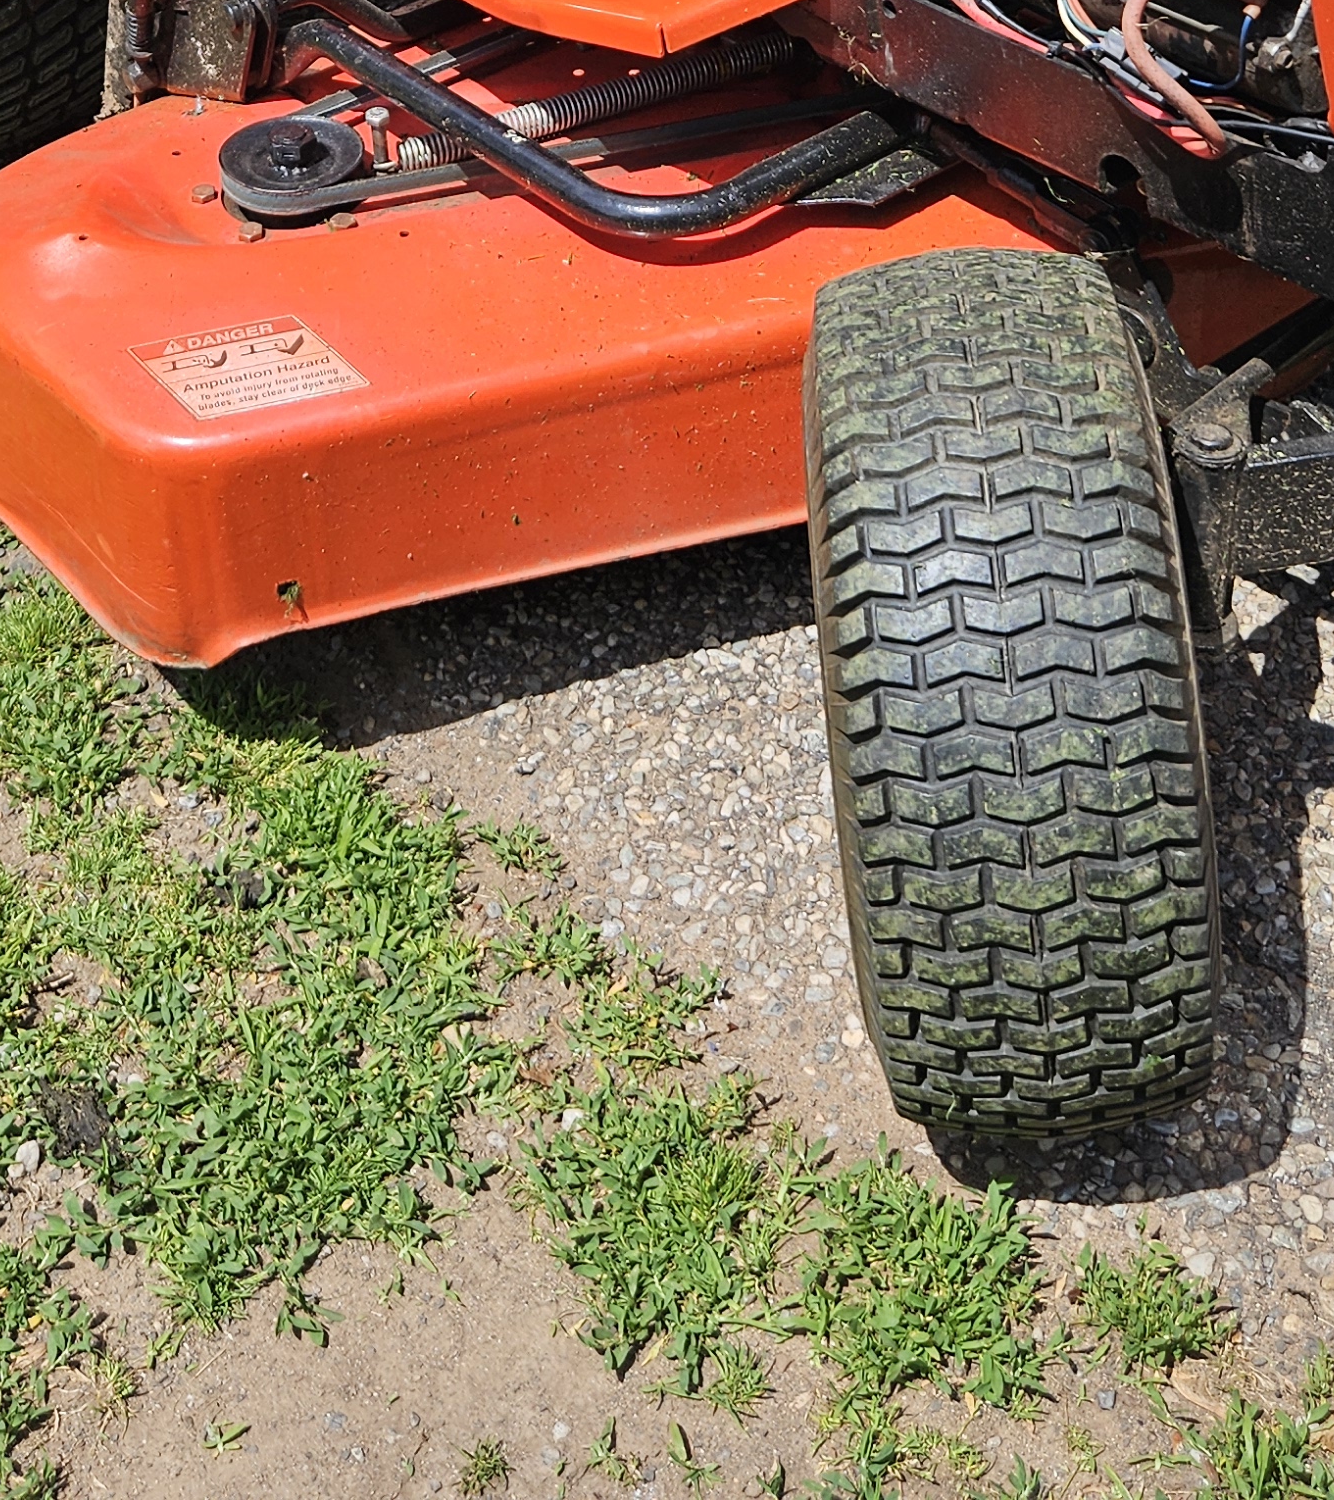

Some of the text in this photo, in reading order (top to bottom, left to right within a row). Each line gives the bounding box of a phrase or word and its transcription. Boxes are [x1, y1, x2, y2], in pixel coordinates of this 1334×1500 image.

[187, 323, 274, 350] DANGER
[183, 356, 330, 393] Amputation Hazard
[201, 367, 339, 401] To avoid injury from rotating
[239, 393, 259, 403] stay
[262, 386, 286, 398] clear
[290, 384, 299, 393] of
